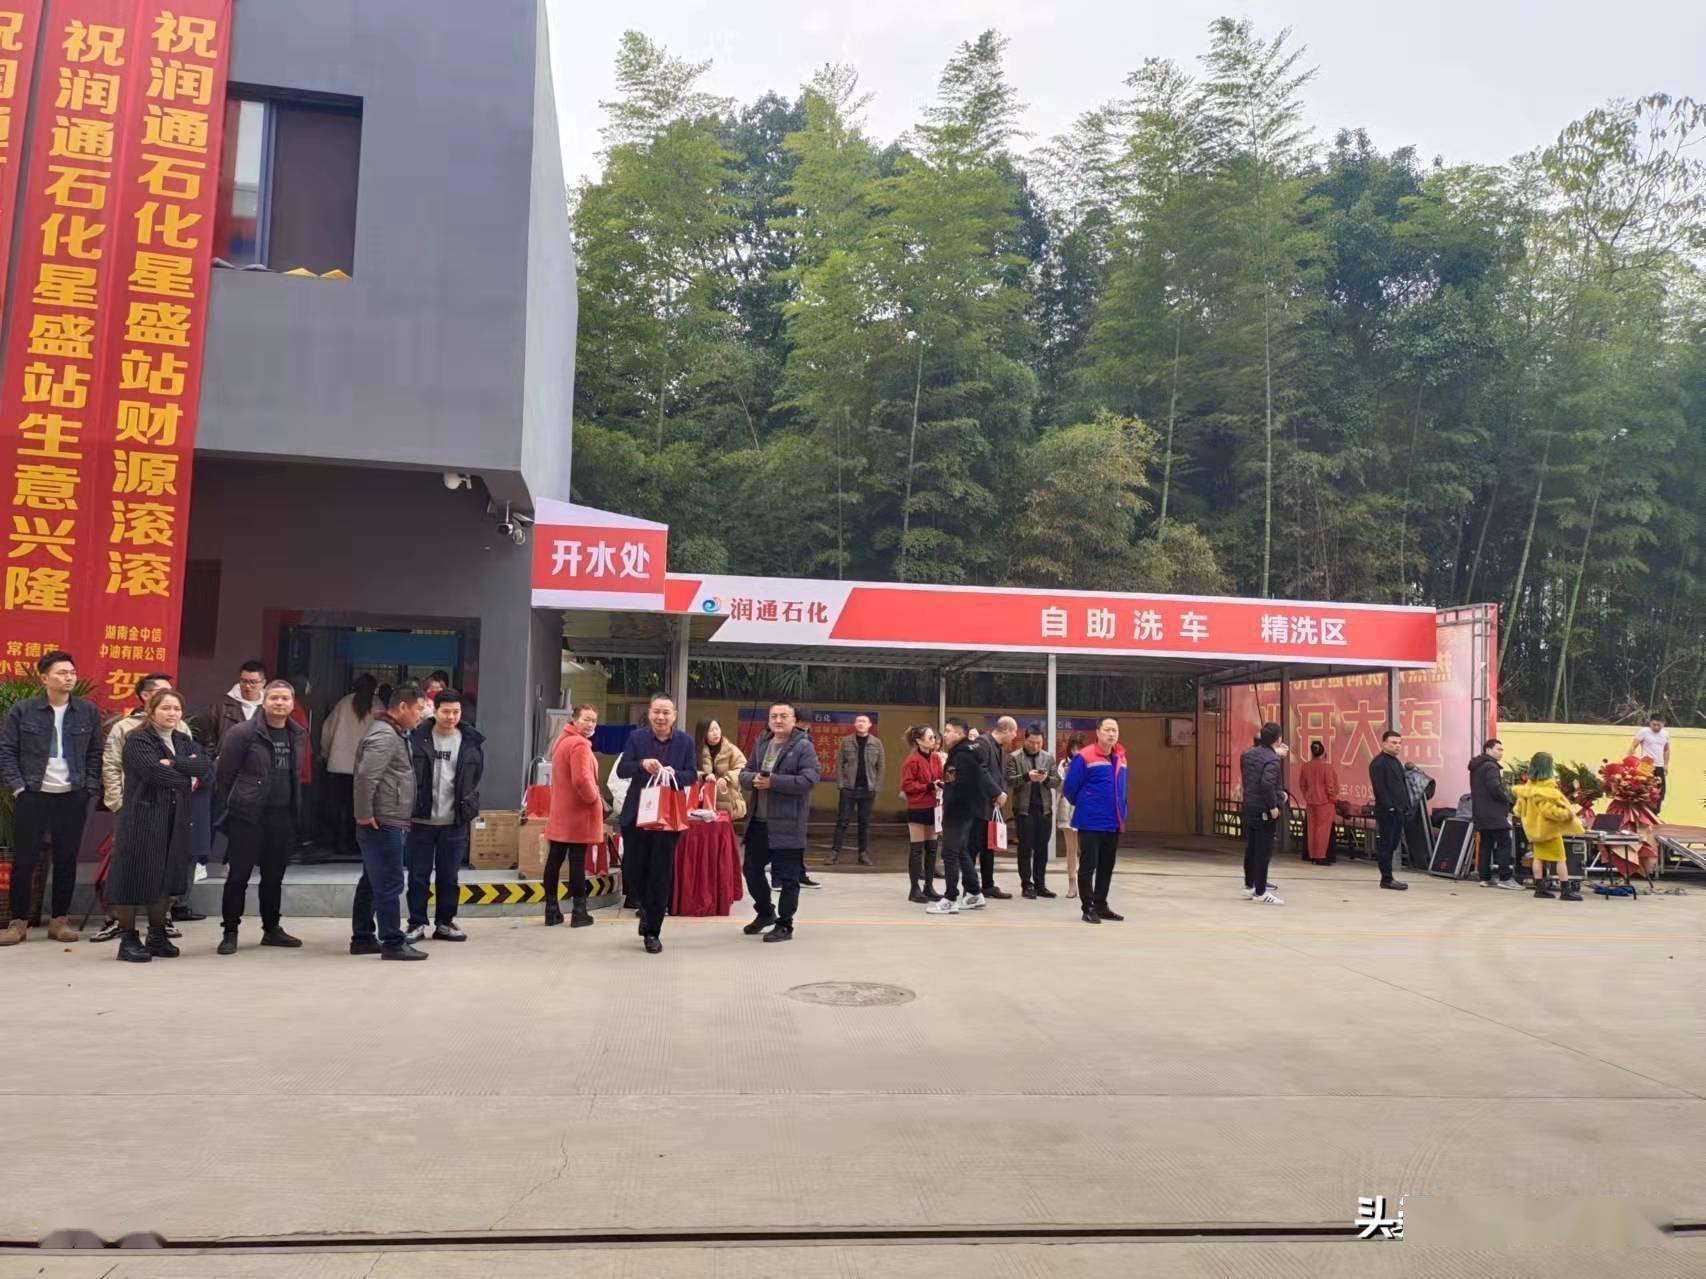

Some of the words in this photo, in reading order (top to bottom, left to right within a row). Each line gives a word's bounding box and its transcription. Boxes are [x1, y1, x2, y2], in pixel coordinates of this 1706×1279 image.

[4, 20, 125, 612] 祝润通石化星盛站生意兴隆
[105, 10, 217, 597] 祝润通石化星盛站财源滚滚
[551, 539, 650, 579] 开水处
[729, 597, 829, 624] 润通石化
[1040, 606, 1209, 643] 自助洗车
[1260, 615, 1349, 646] 精洗区
